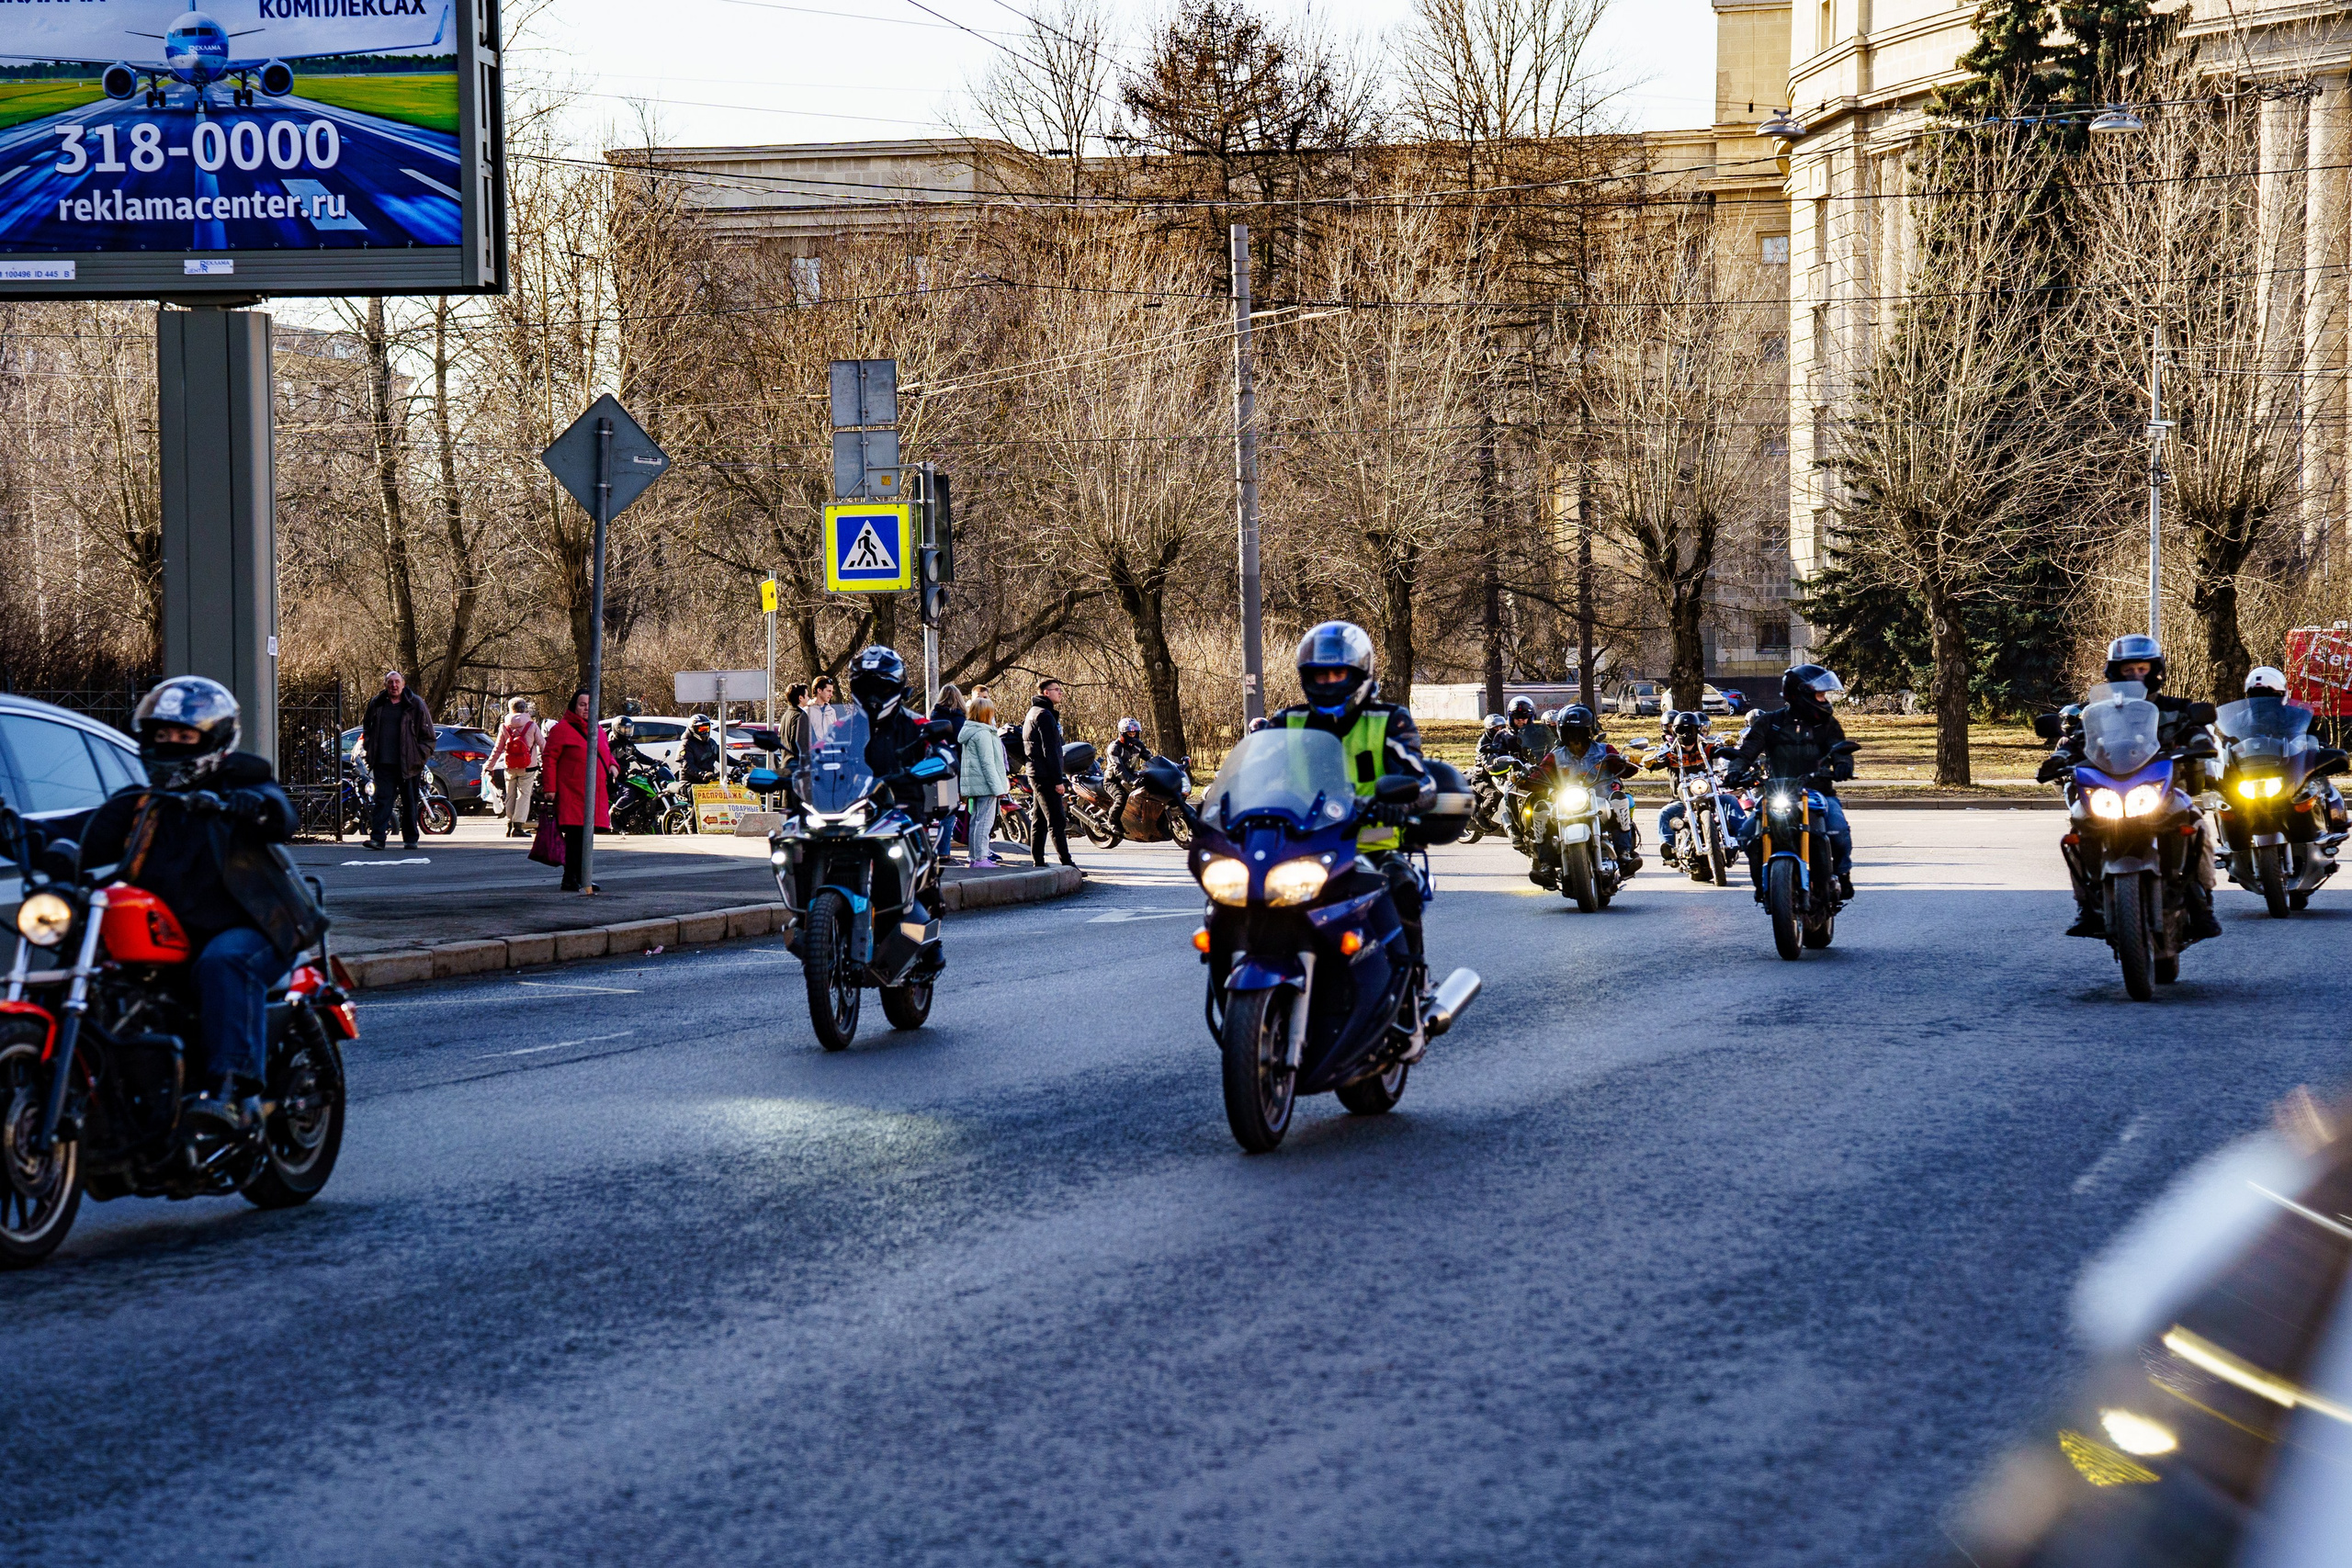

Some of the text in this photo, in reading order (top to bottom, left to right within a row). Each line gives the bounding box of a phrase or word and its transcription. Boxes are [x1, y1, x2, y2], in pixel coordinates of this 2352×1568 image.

[259, 0, 427, 18] КОМПЛЕКСАХ
[54, 120, 340, 174] 318-0000
[59, 189, 346, 221] reklamacenter.ru
[5, 270, 31, 278] 100496
